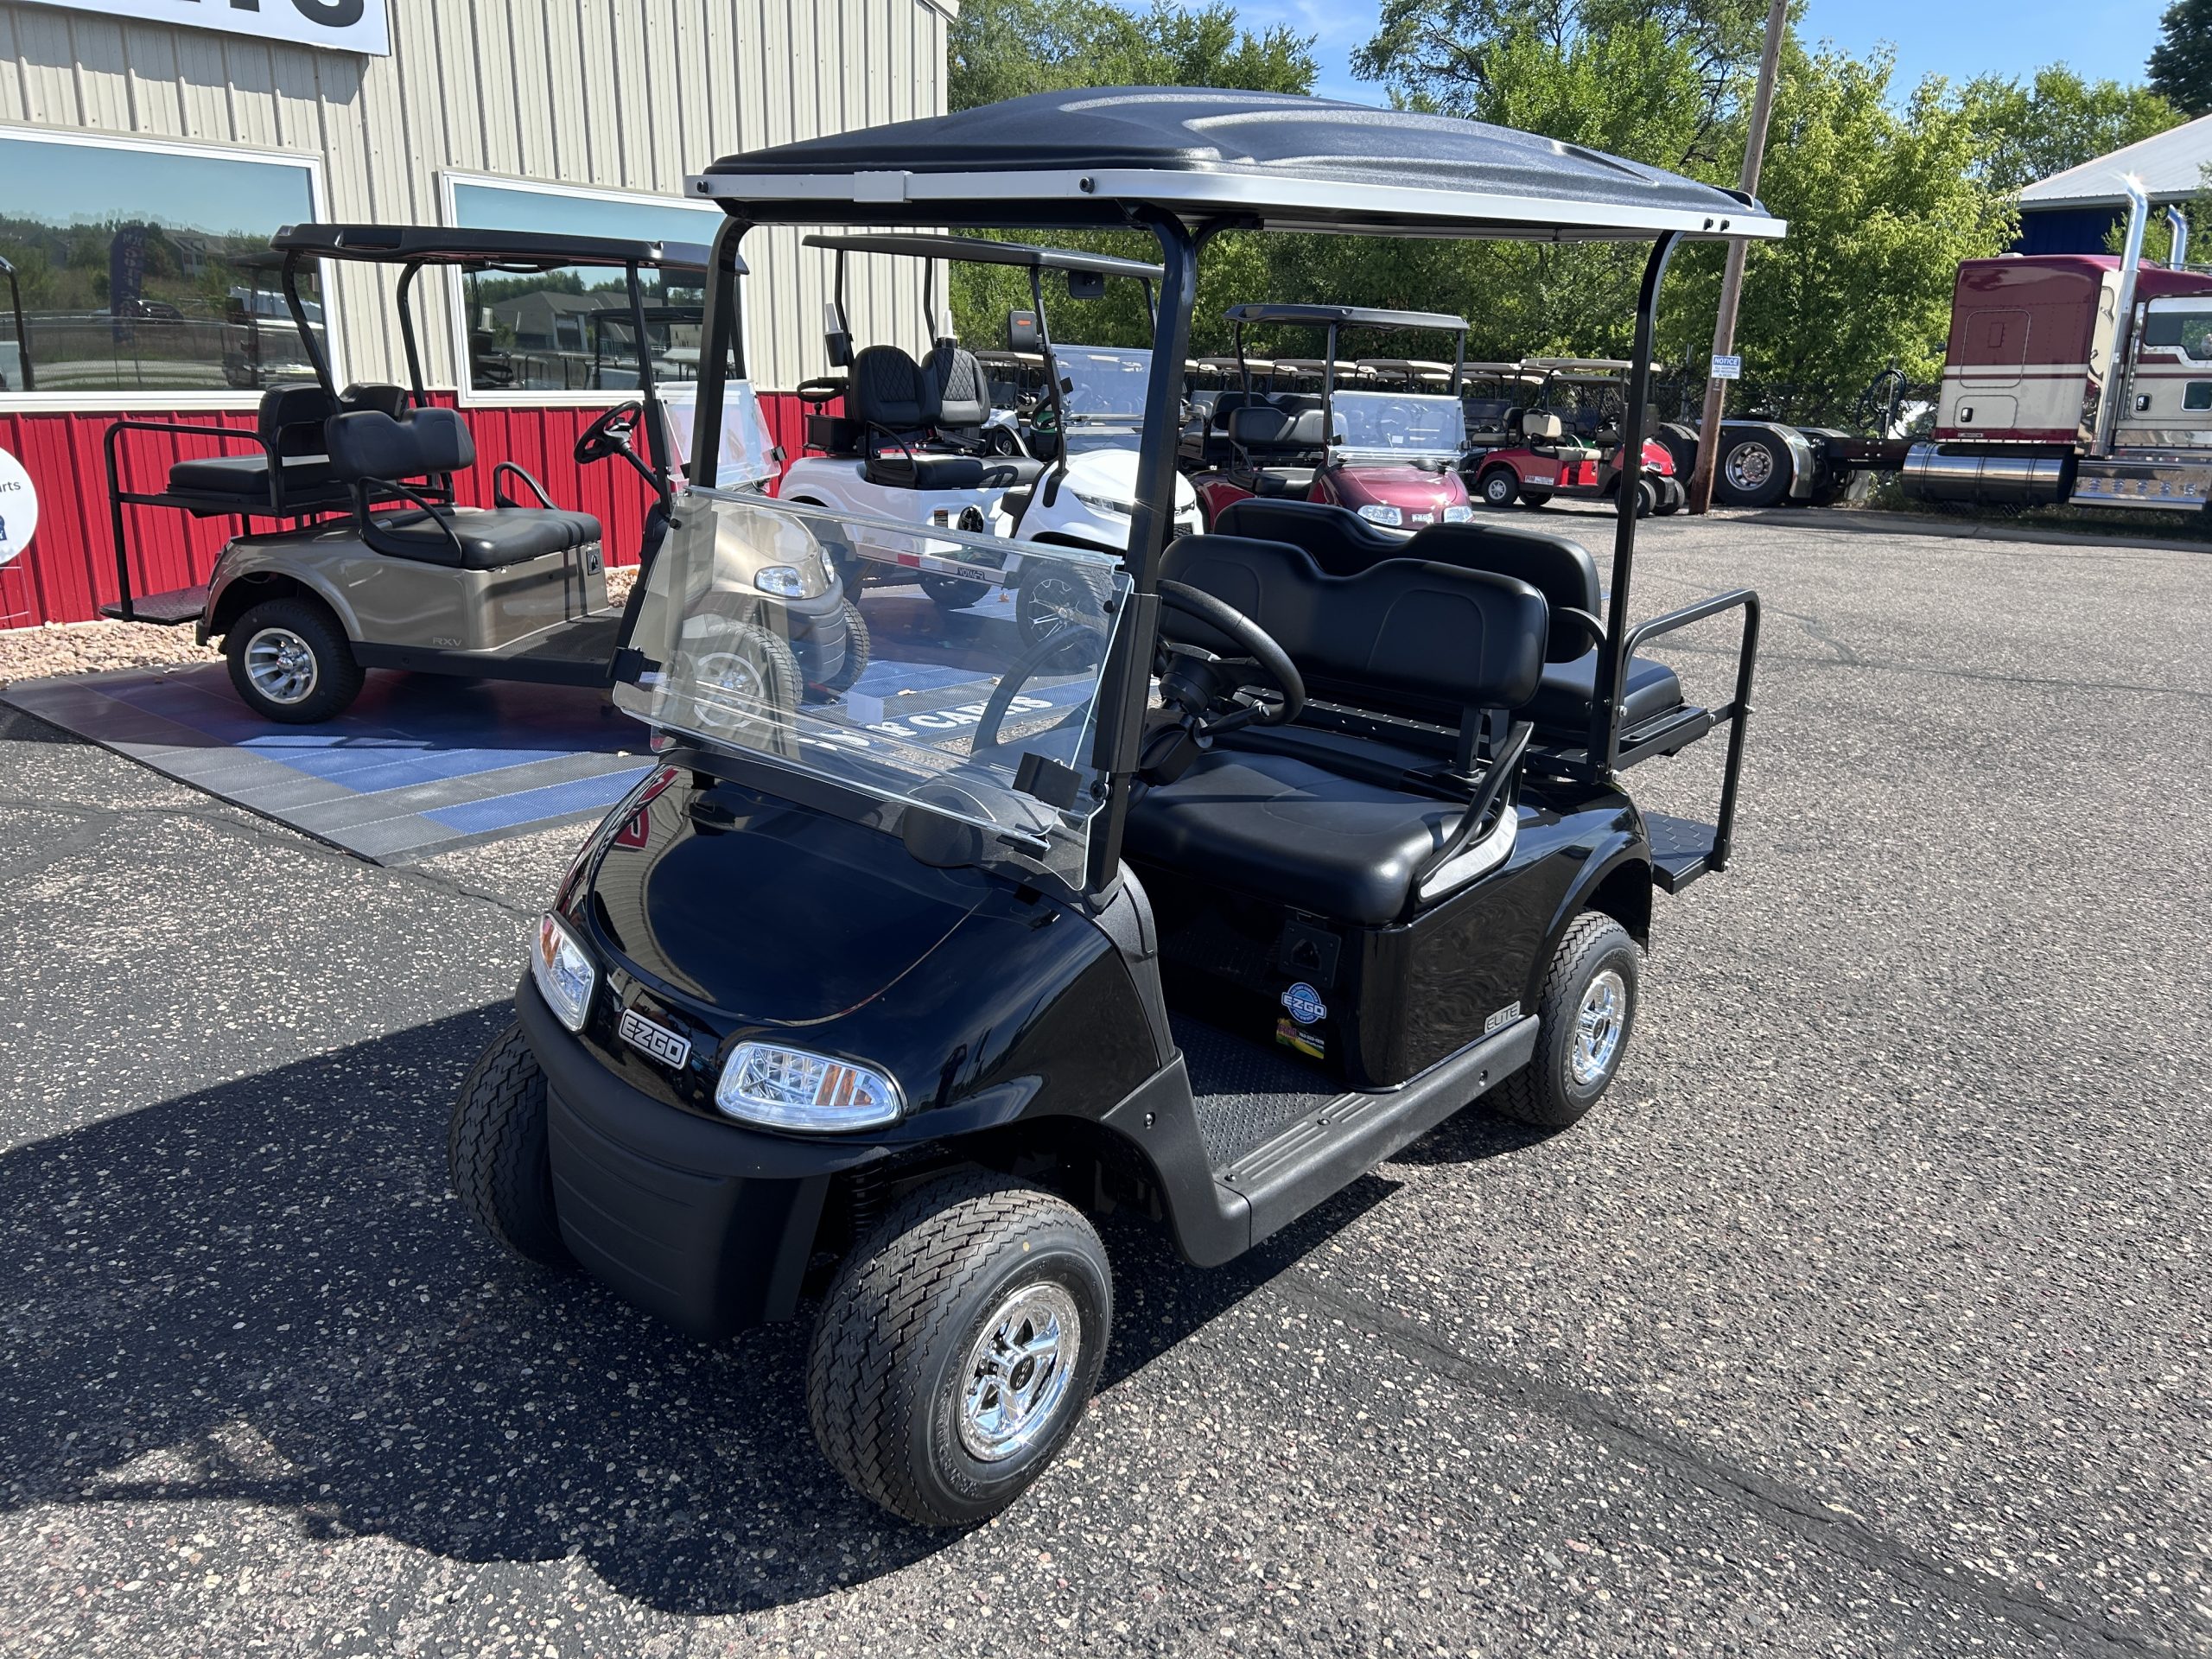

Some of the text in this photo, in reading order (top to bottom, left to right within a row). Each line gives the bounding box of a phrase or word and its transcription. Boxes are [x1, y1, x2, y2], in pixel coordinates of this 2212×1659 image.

[1714, 357, 1738, 365] NOTICE
[433, 636, 462, 646] RXV
[621, 1014, 684, 1064] EZGO
